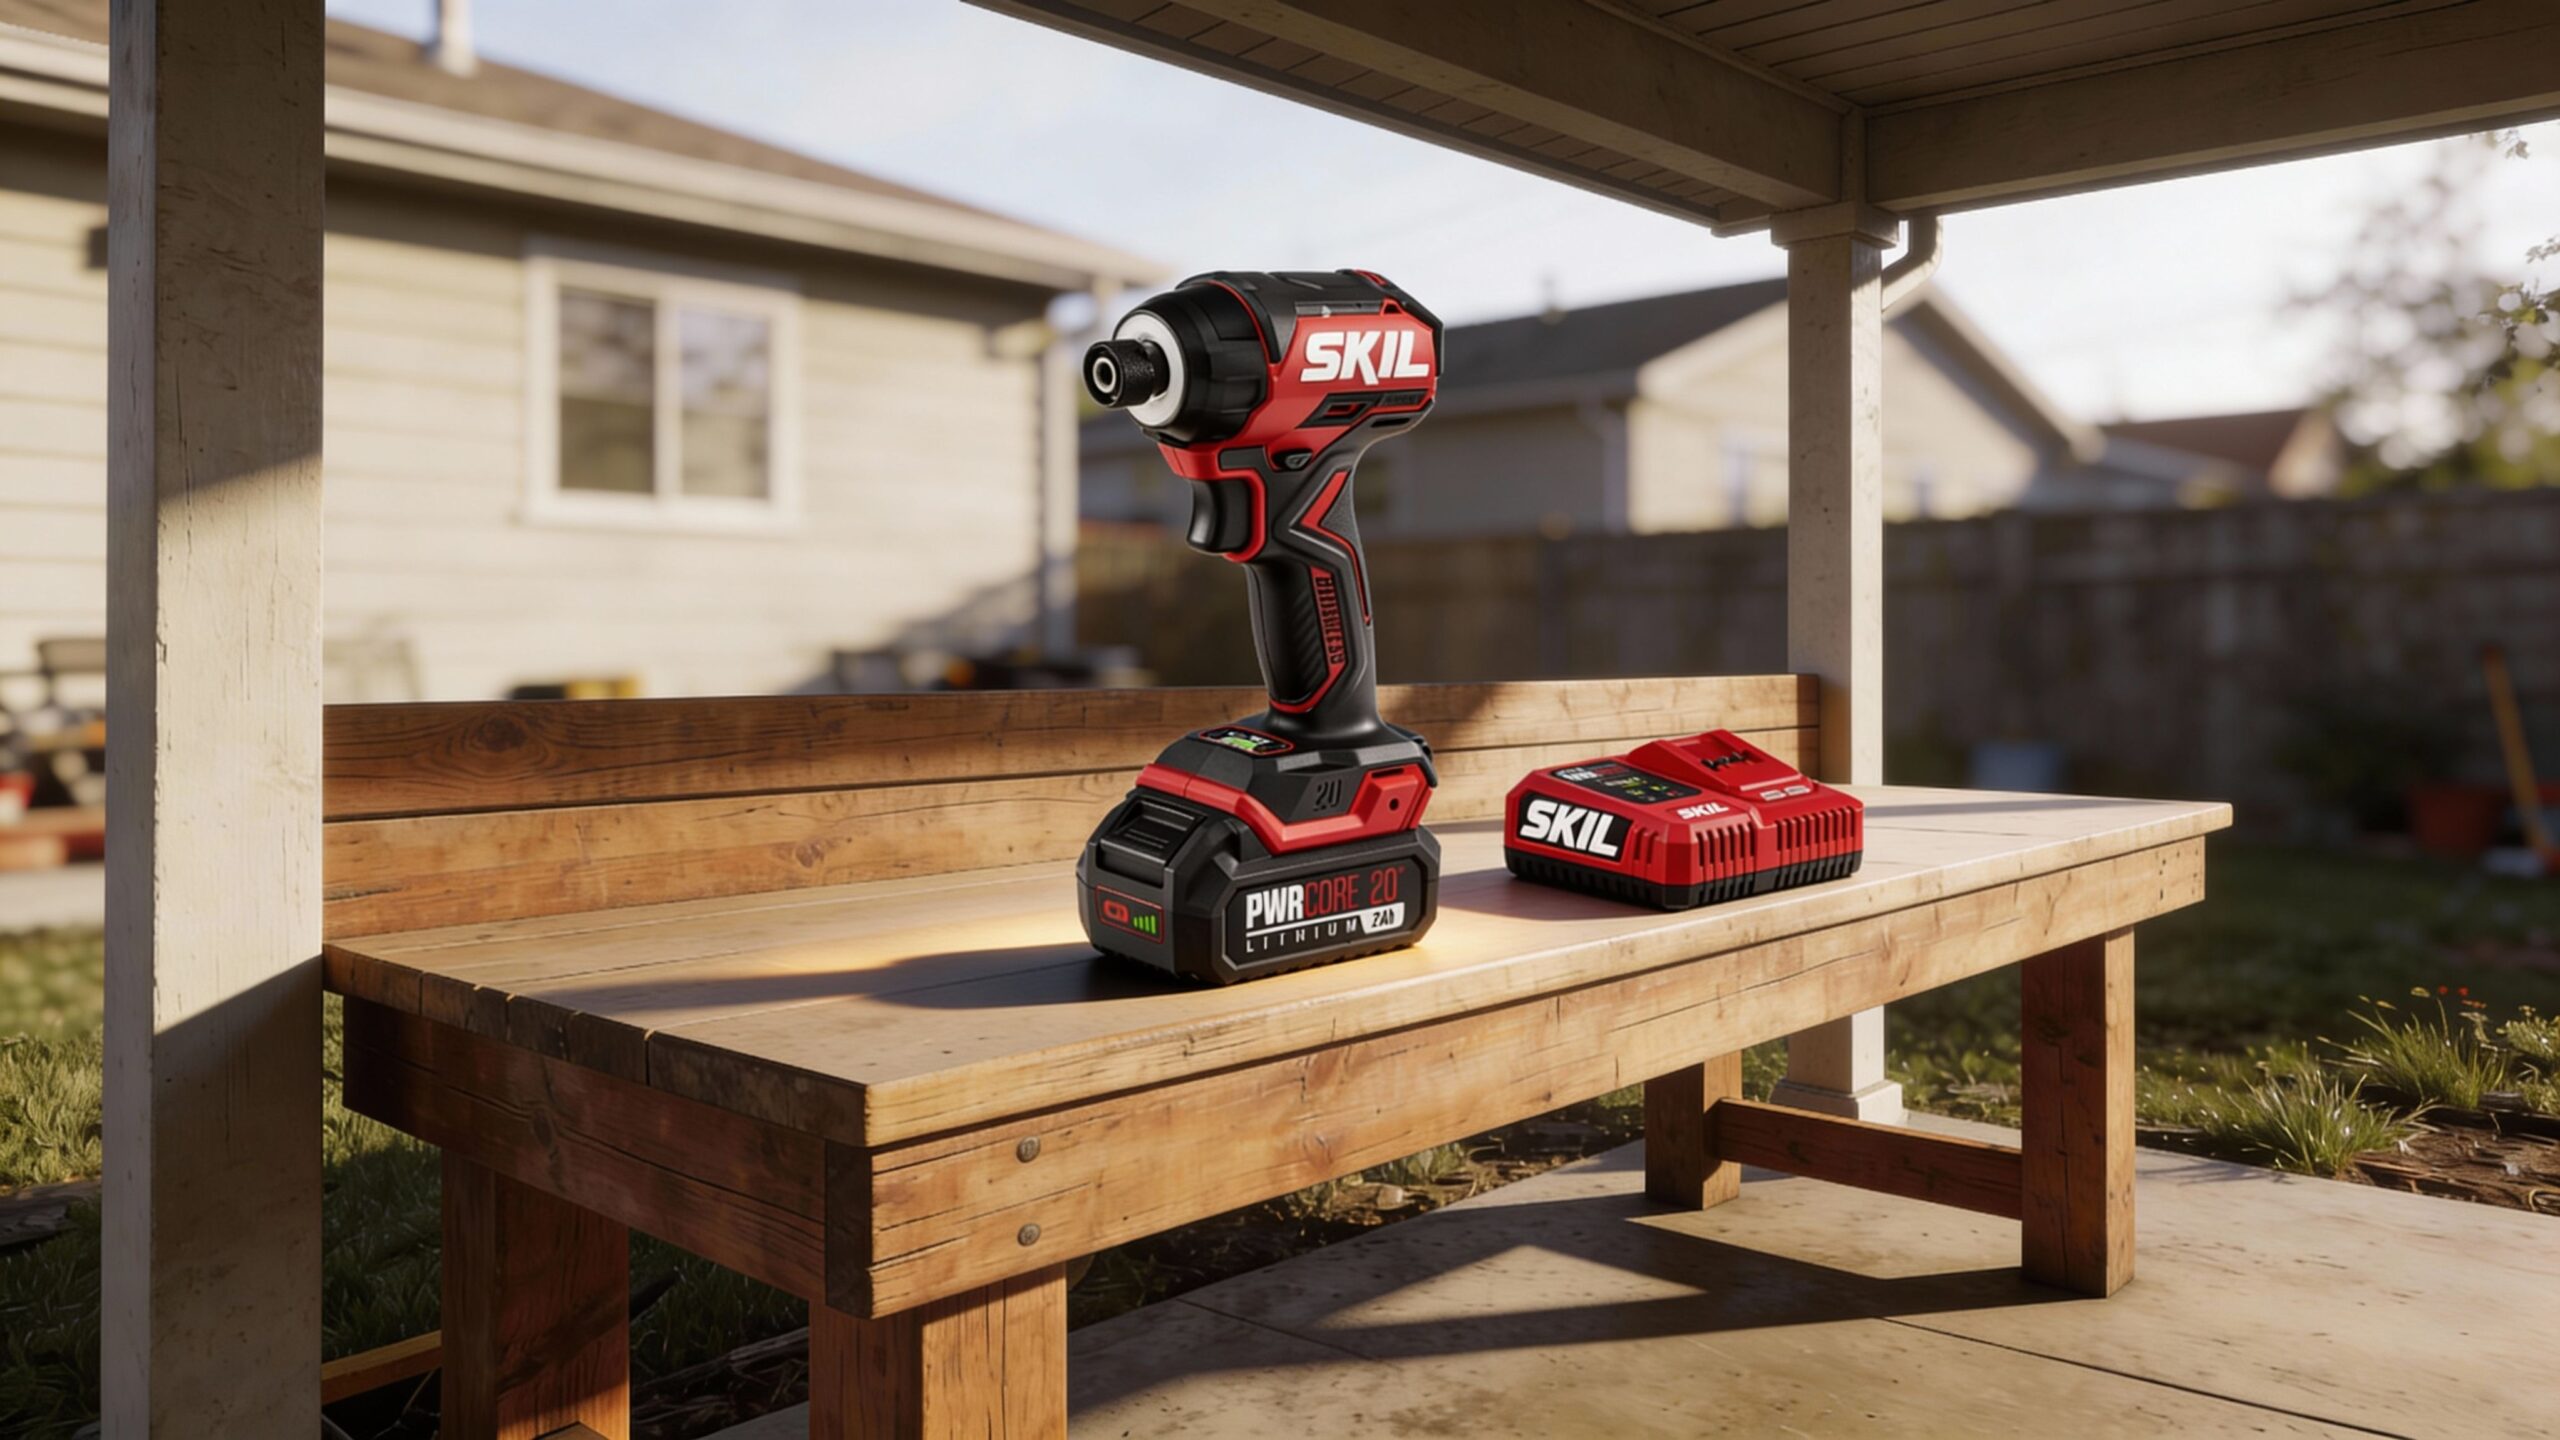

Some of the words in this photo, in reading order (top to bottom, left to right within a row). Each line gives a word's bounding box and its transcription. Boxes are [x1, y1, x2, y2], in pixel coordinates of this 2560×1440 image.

[1300, 330, 1430, 385] SKIL
[1313, 779, 1343, 811] 20
[1677, 802, 1731, 820] SKIL
[1519, 799, 1619, 857] SKIL
[1245, 874, 1360, 930] PWRCORE
[1246, 918, 1357, 953] LITHIUM
